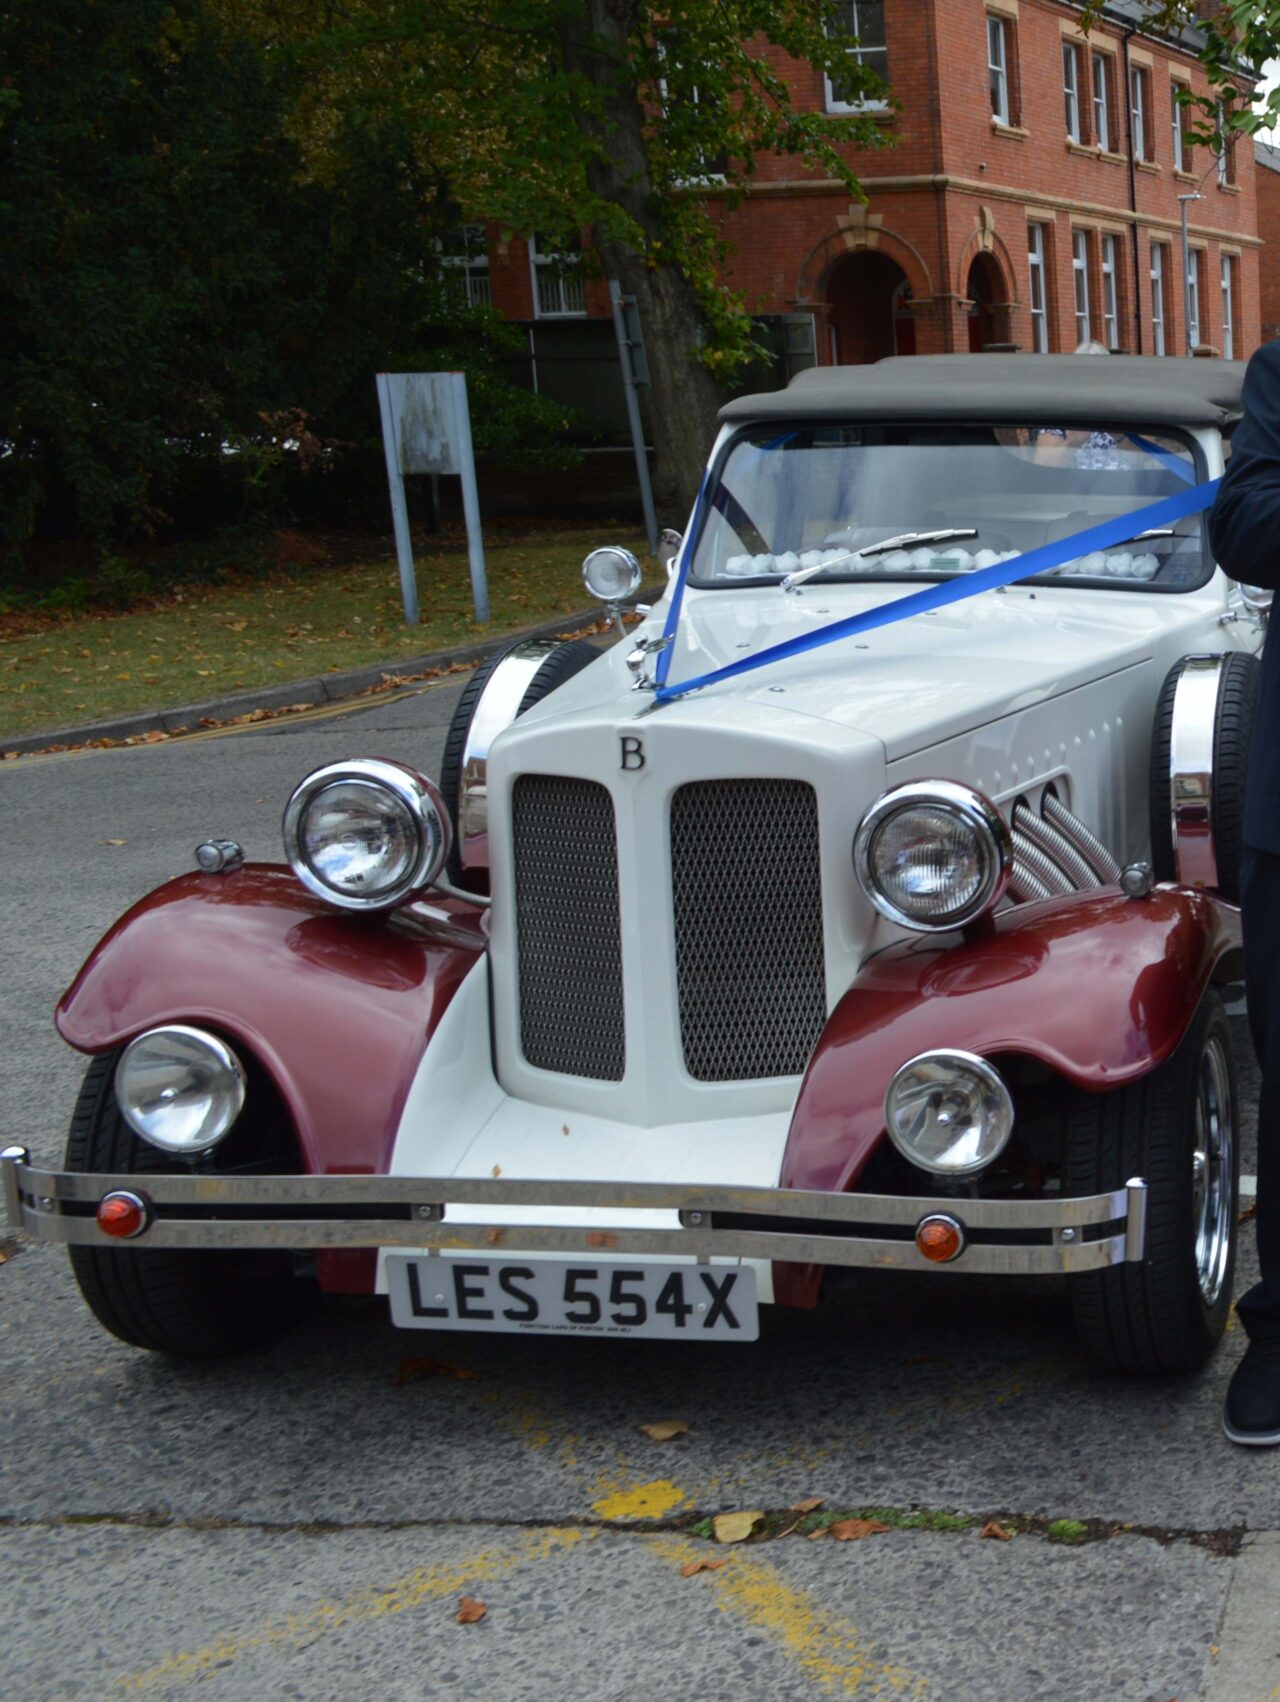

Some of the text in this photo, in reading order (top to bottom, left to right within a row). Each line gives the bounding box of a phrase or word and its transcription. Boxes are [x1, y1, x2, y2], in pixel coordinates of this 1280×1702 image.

[620, 736, 646, 770] B
[406, 1262, 742, 1329] LES 554X
